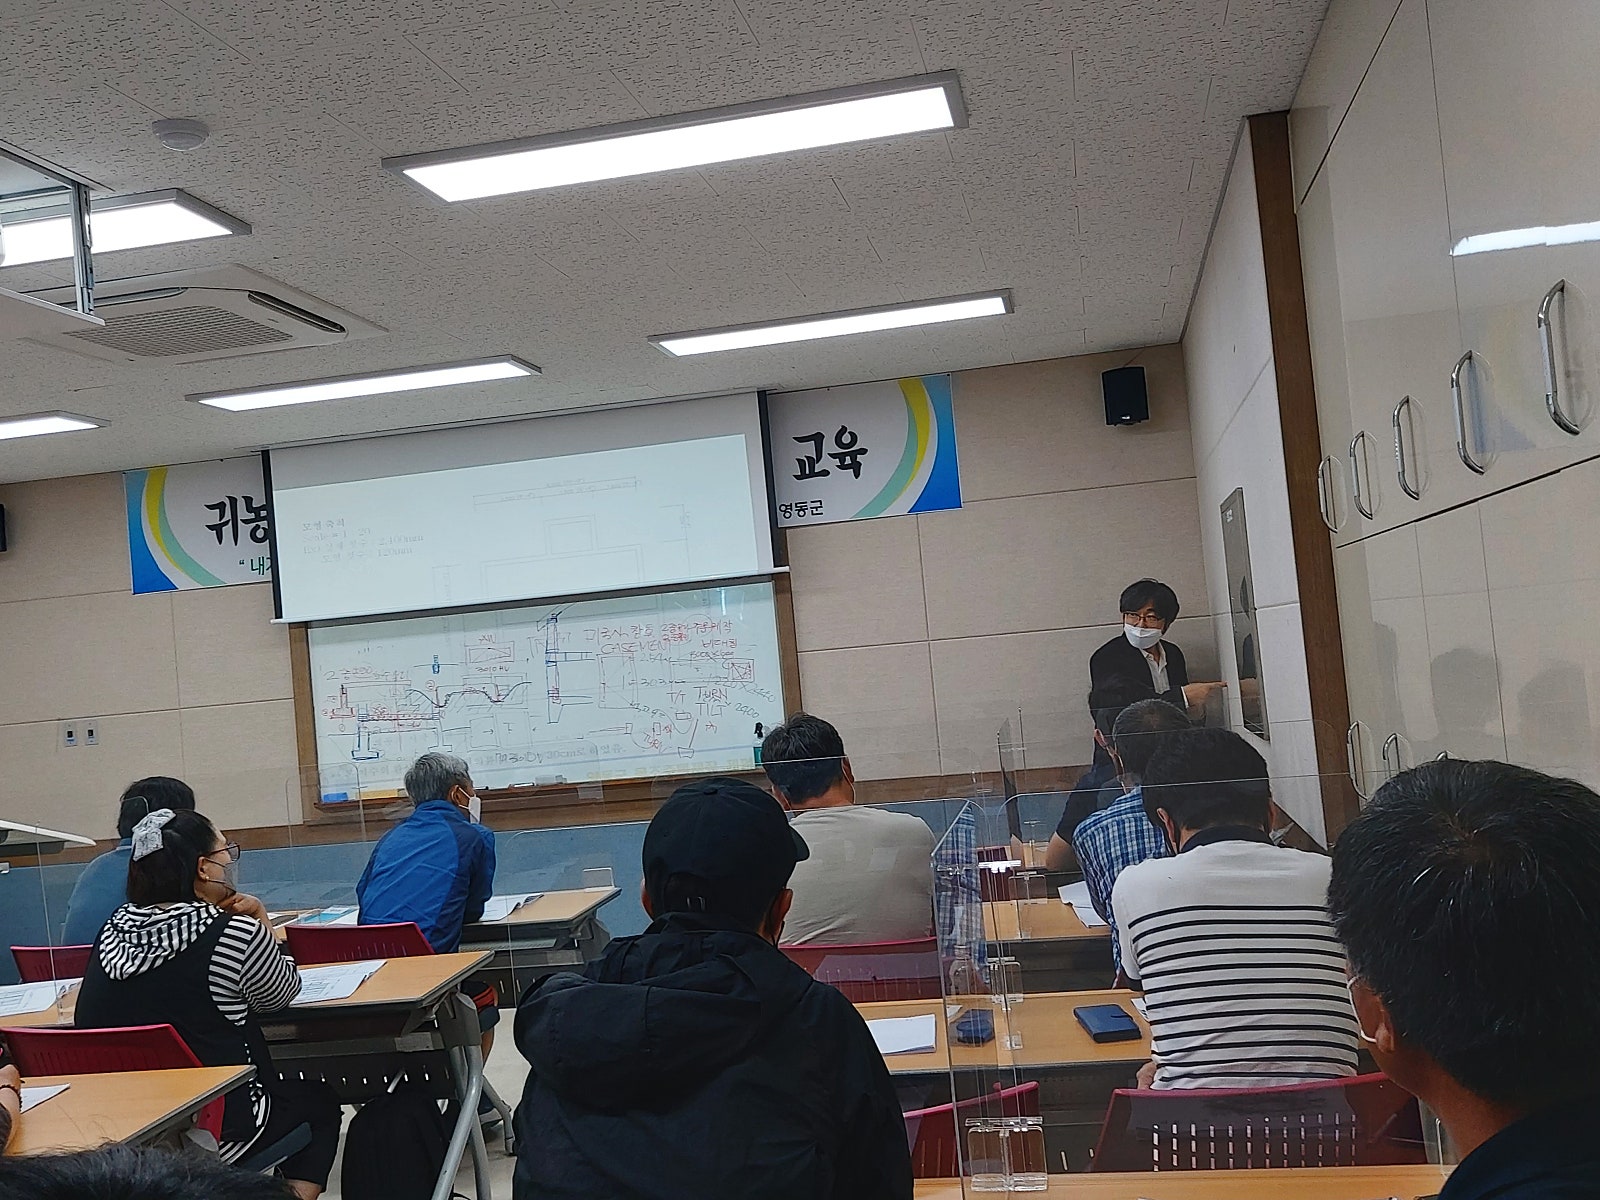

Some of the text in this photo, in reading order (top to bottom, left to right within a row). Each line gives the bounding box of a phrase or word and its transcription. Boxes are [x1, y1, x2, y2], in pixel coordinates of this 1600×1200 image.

[792, 425, 868, 481] 교육
[204, 495, 270, 547] 귀농
[778, 499, 824, 519] 영동군
